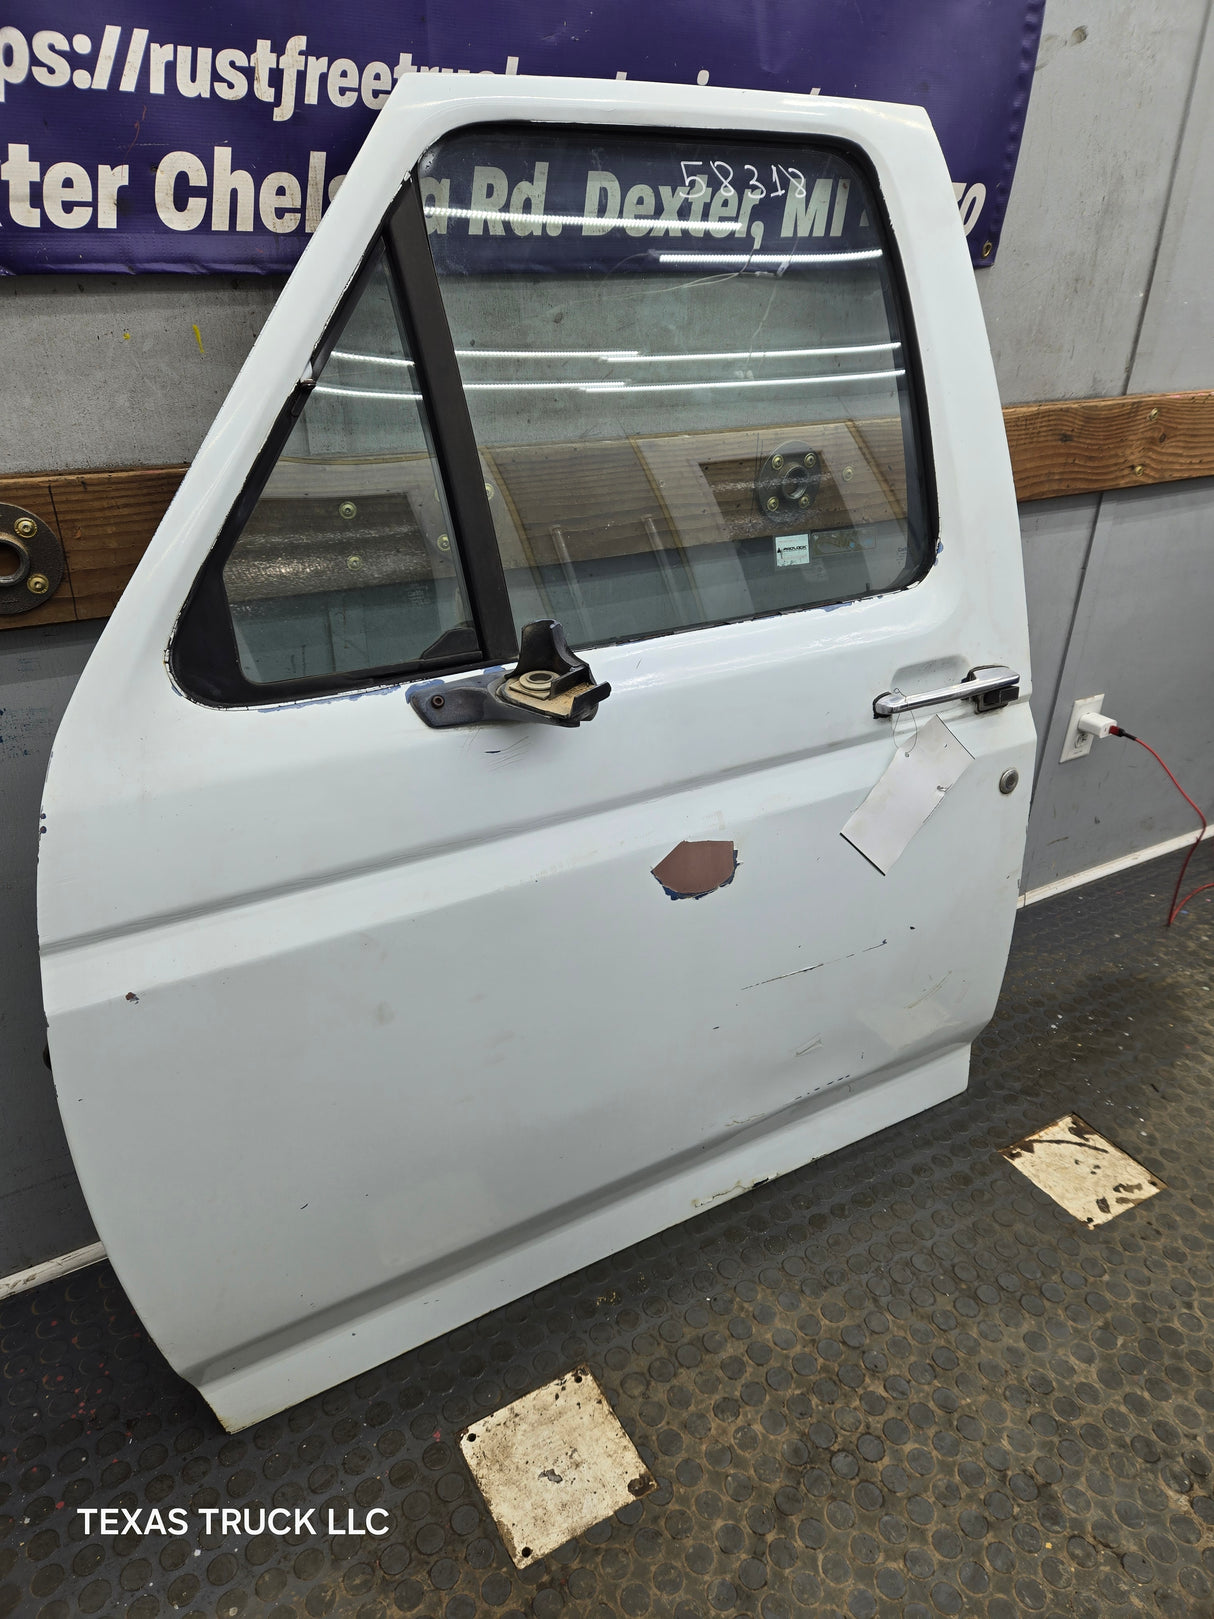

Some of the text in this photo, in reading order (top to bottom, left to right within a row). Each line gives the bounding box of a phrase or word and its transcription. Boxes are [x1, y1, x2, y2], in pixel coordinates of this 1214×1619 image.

[0, 143, 129, 230] ter
[468, 161, 562, 236] Rd.
[581, 170, 764, 250] Dexter,
[780, 178, 849, 238] MI
[679, 160, 807, 199] 58318
